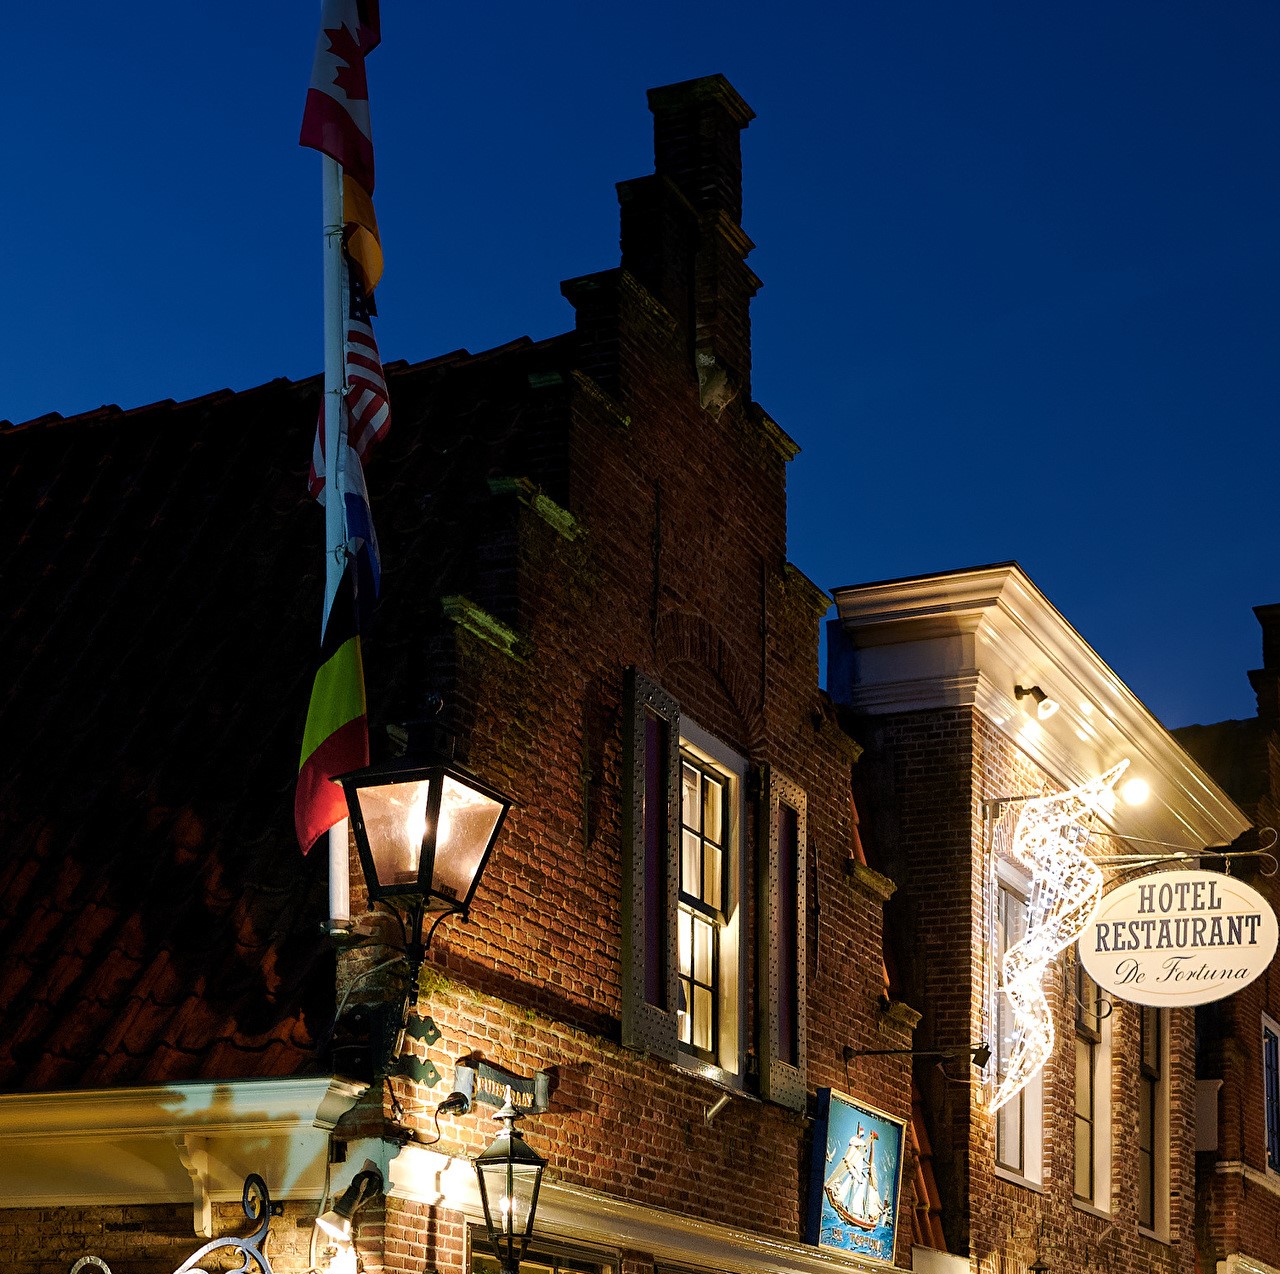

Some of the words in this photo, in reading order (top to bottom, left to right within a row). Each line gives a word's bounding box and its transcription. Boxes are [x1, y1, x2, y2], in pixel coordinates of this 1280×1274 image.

[1137, 881, 1222, 914] HOTEL
[1095, 914, 1261, 952] RESTAURANT
[1114, 958, 1146, 986] De
[1156, 954, 1250, 983] Fortuna
